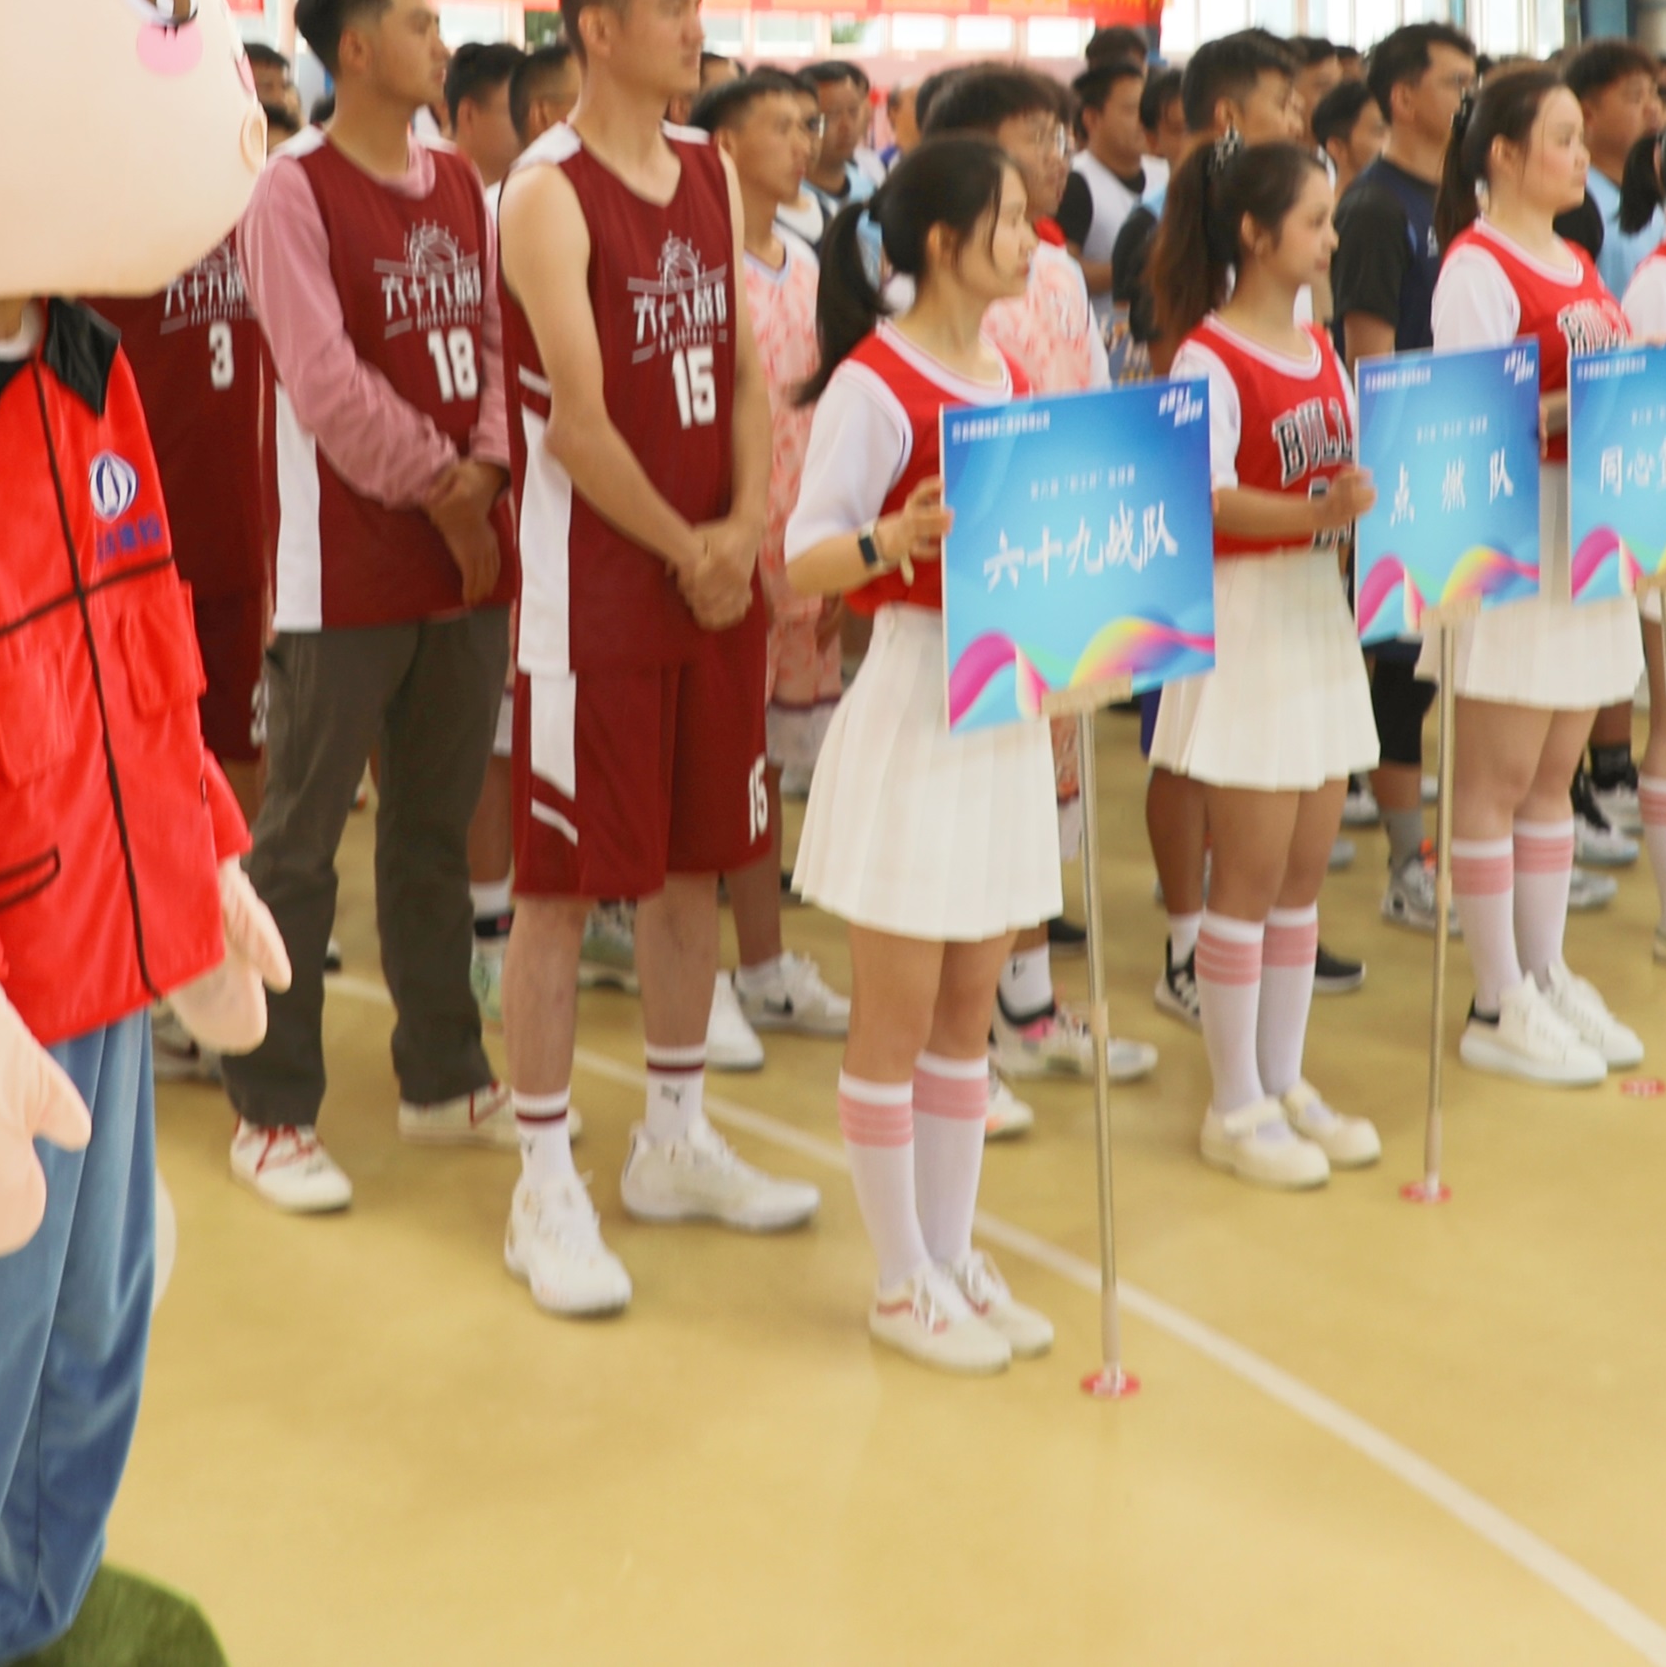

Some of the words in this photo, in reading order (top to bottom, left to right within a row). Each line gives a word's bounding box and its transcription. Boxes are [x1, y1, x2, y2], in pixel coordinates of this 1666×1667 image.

[209, 320, 234, 391] 3
[428, 326, 479, 404] 18
[672, 346, 716, 430] 15
[984, 499, 1178, 594] 六十九战队
